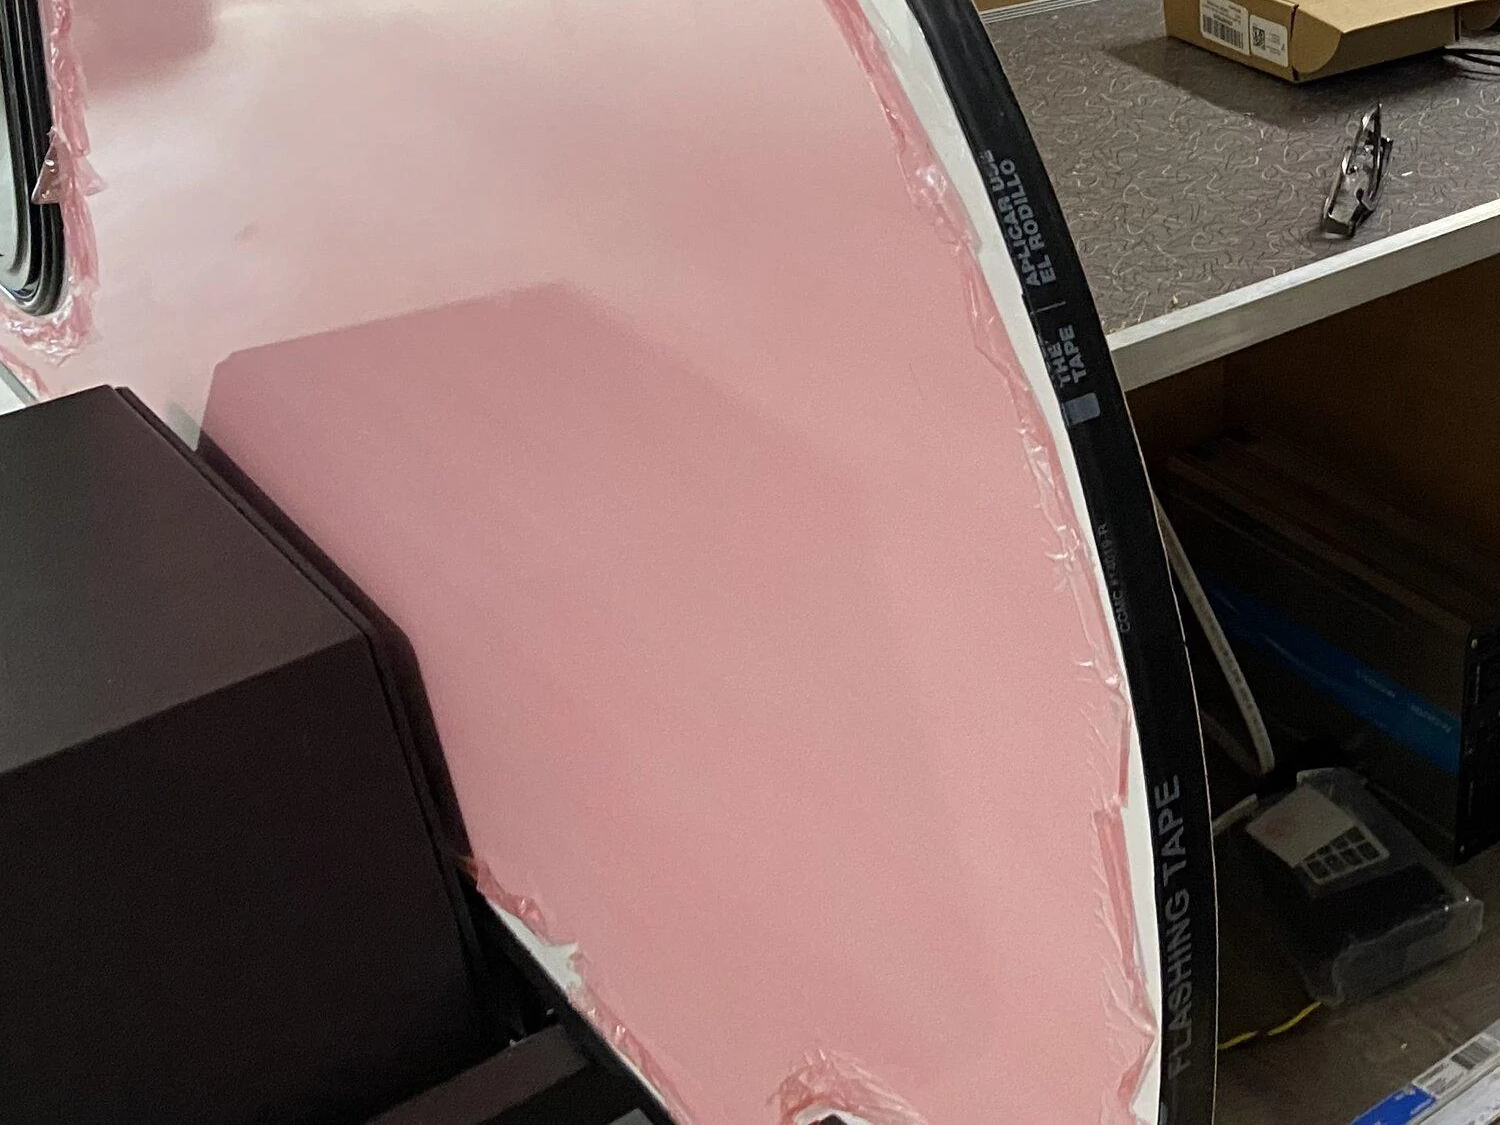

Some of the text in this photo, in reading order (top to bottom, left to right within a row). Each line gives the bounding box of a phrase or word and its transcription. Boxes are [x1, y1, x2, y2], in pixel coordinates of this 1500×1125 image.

[998, 195, 1041, 286] APLICAR
[999, 159, 1057, 285] EL RODILLO
[1047, 342, 1071, 388] THE
[1059, 324, 1087, 383] TAPE
[1154, 774, 1193, 1080] FLASHING TAPE
